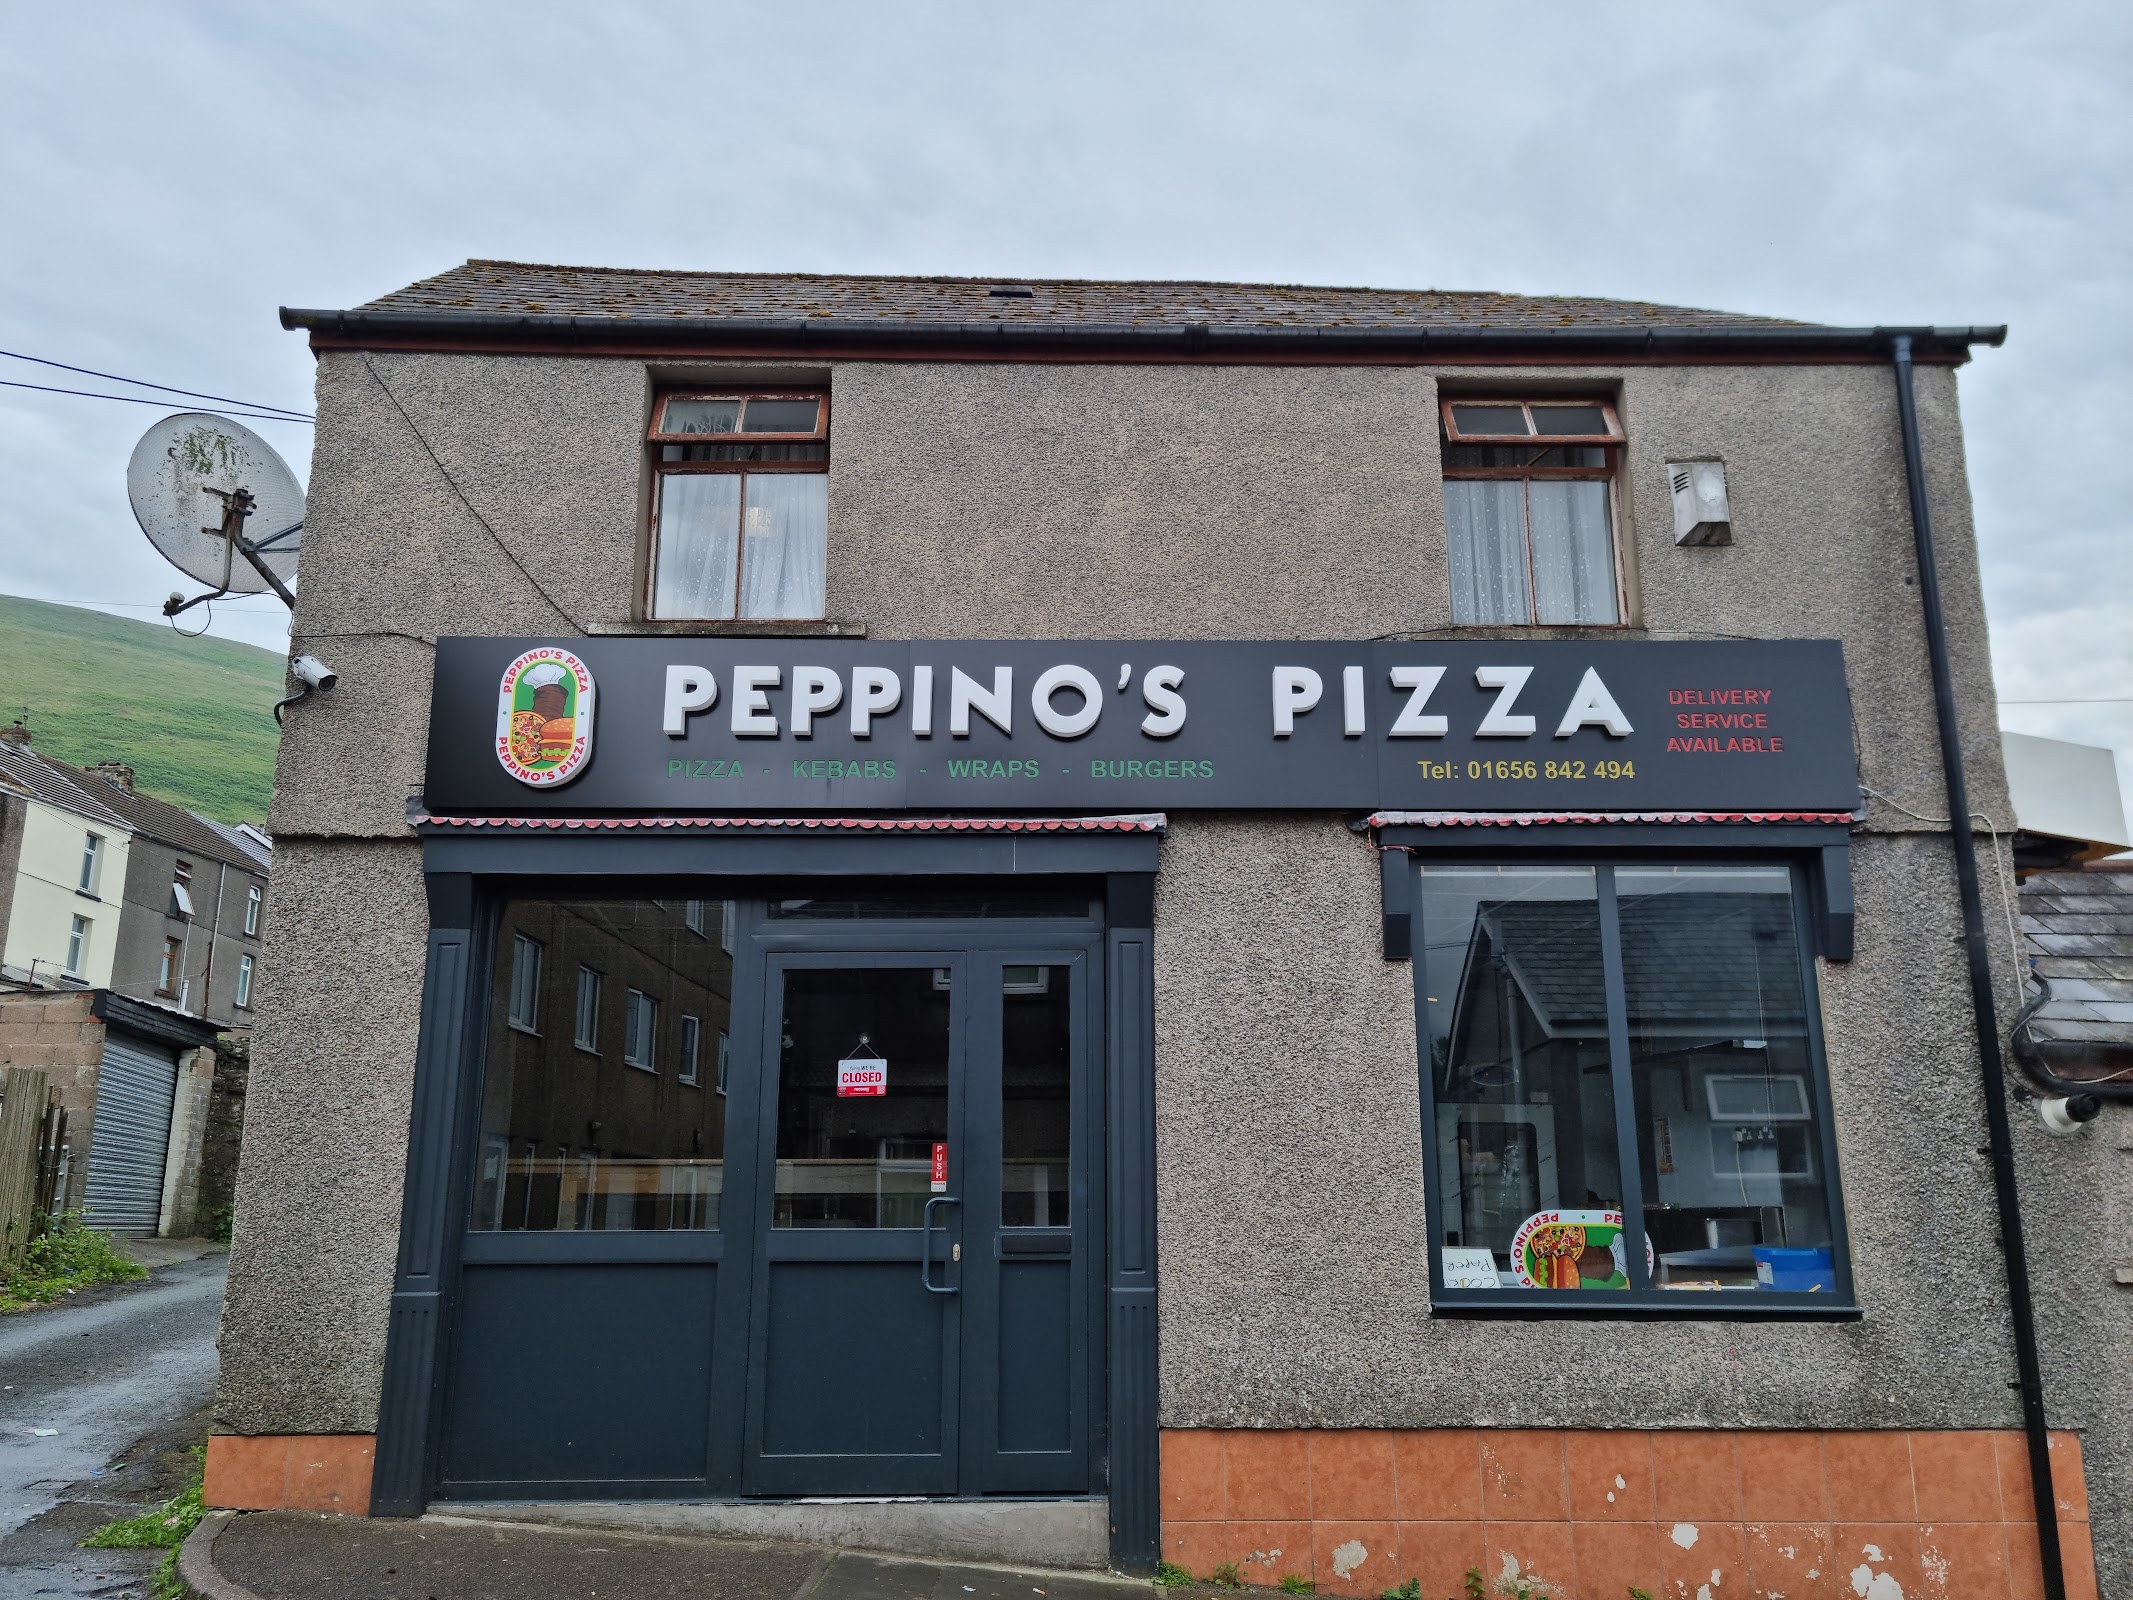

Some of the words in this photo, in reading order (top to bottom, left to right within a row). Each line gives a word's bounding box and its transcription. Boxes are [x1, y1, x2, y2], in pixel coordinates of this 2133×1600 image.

[503, 650, 563, 693] PEPPINO'S
[565, 656, 588, 693] PIZZA
[663, 663, 1187, 738] PEPPINO'S
[1272, 665, 1635, 737] PIZZA
[1669, 689, 1772, 705] DELIVERY
[1677, 713, 1768, 729] SERVICE
[1666, 737, 1784, 753] AVAILABLE
[498, 736, 556, 782] PEPPINO'S
[558, 736, 586, 775] PIZZA
[667, 759, 745, 778] PIZZA
[792, 759, 897, 779] KEBABS
[948, 759, 1040, 779] WRAPS
[1090, 759, 1214, 779] BURGERS
[1418, 760, 1459, 780] Tel:
[1467, 760, 1538, 780] 01656
[1545, 760, 1586, 780] 842
[1593, 760, 1635, 780] 494
[842, 1071, 882, 1083] CLOSED
[1513, 1212, 1559, 1274] PEPPINO'S
